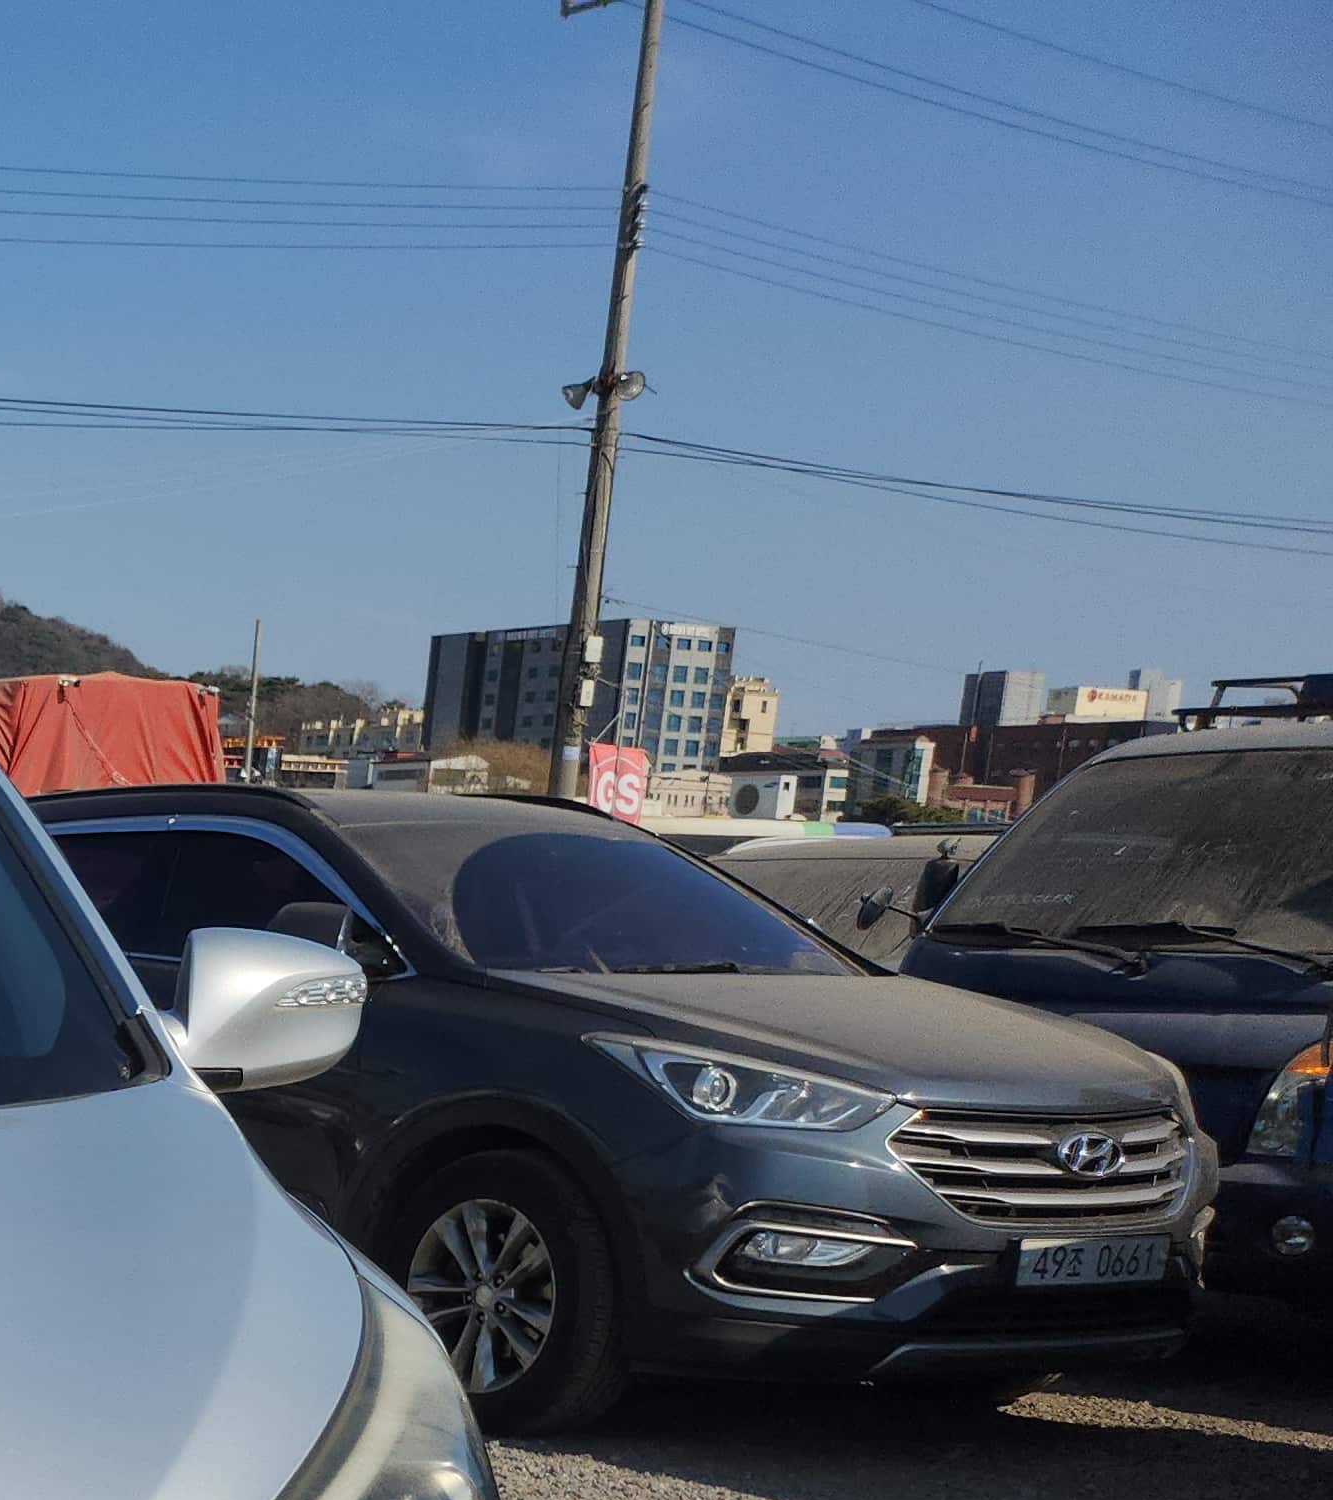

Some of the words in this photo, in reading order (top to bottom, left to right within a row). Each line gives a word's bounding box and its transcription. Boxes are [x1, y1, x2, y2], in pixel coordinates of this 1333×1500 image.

[597, 771, 641, 815] GS
[1031, 1246, 1084, 1280] 49조
[1096, 1243, 1155, 1277] 0661
